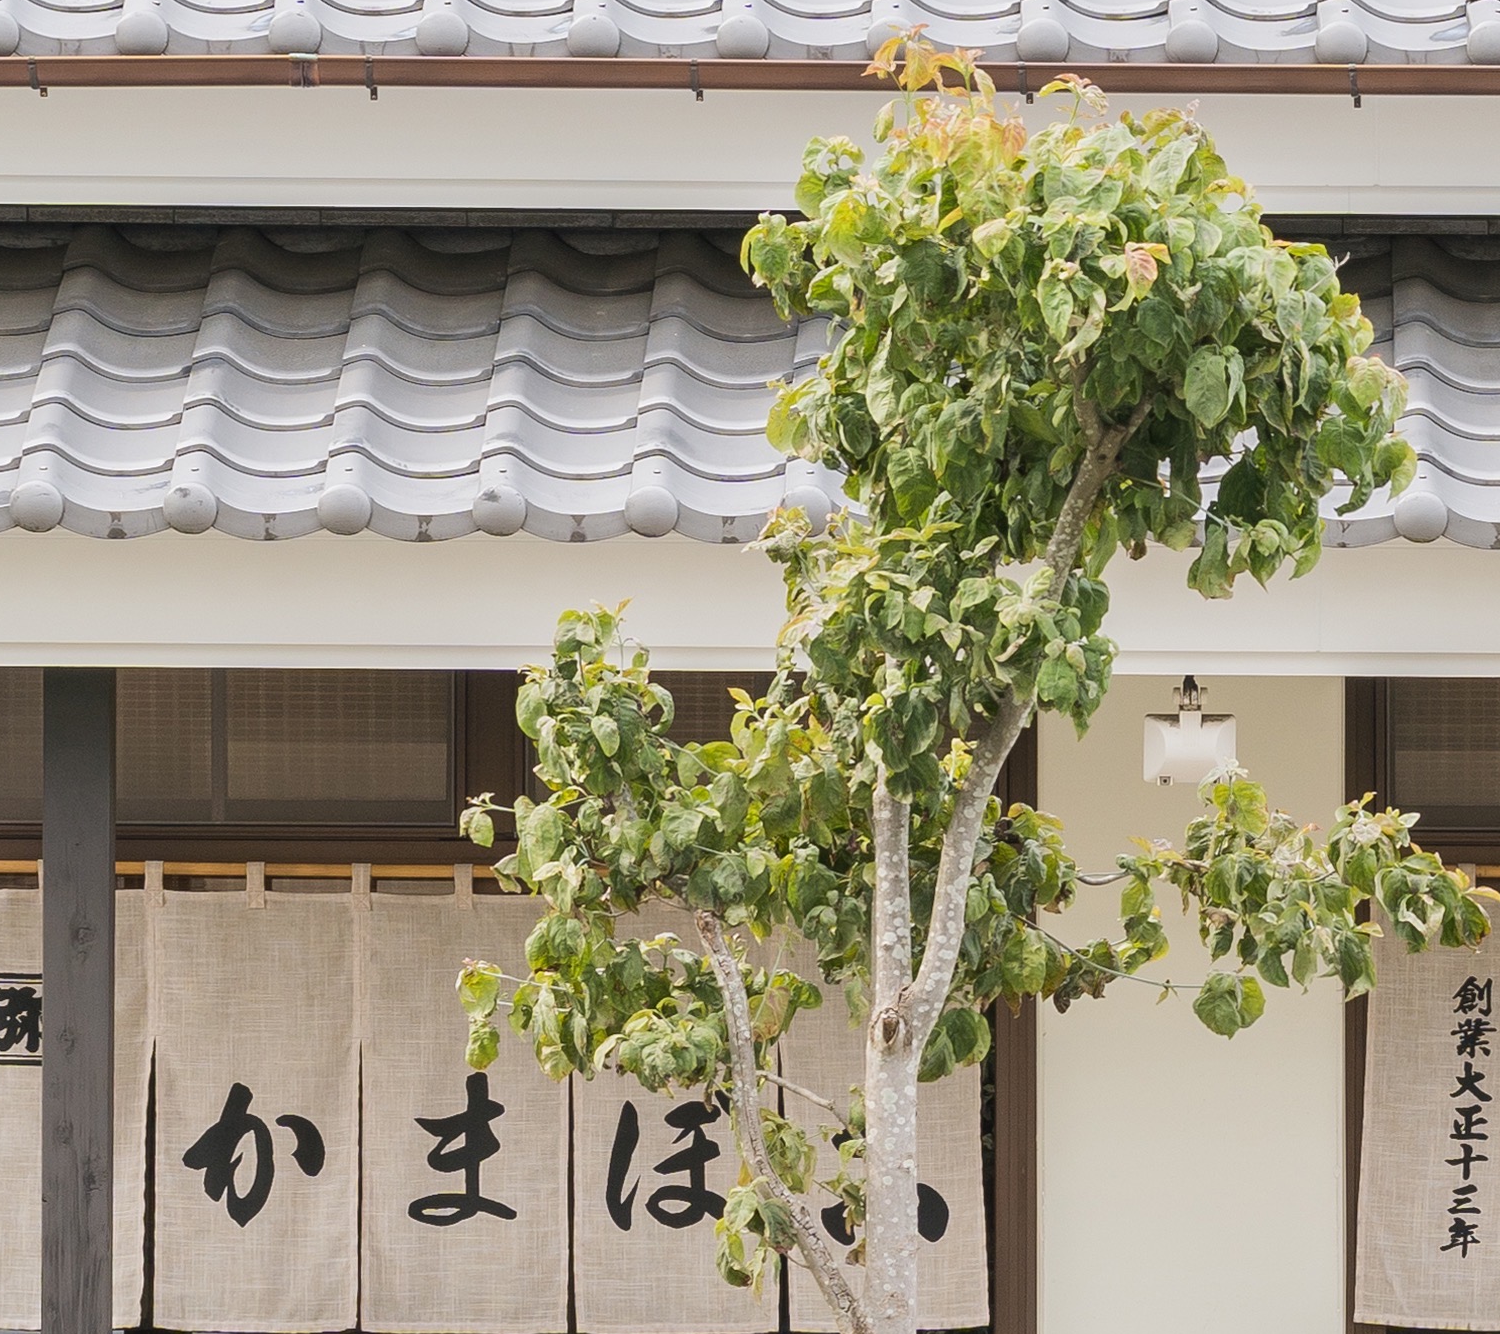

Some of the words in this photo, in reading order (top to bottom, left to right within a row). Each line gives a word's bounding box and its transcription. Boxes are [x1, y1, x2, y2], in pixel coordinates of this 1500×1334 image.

[1440, 975, 1498, 1259] 創業大正十三年
